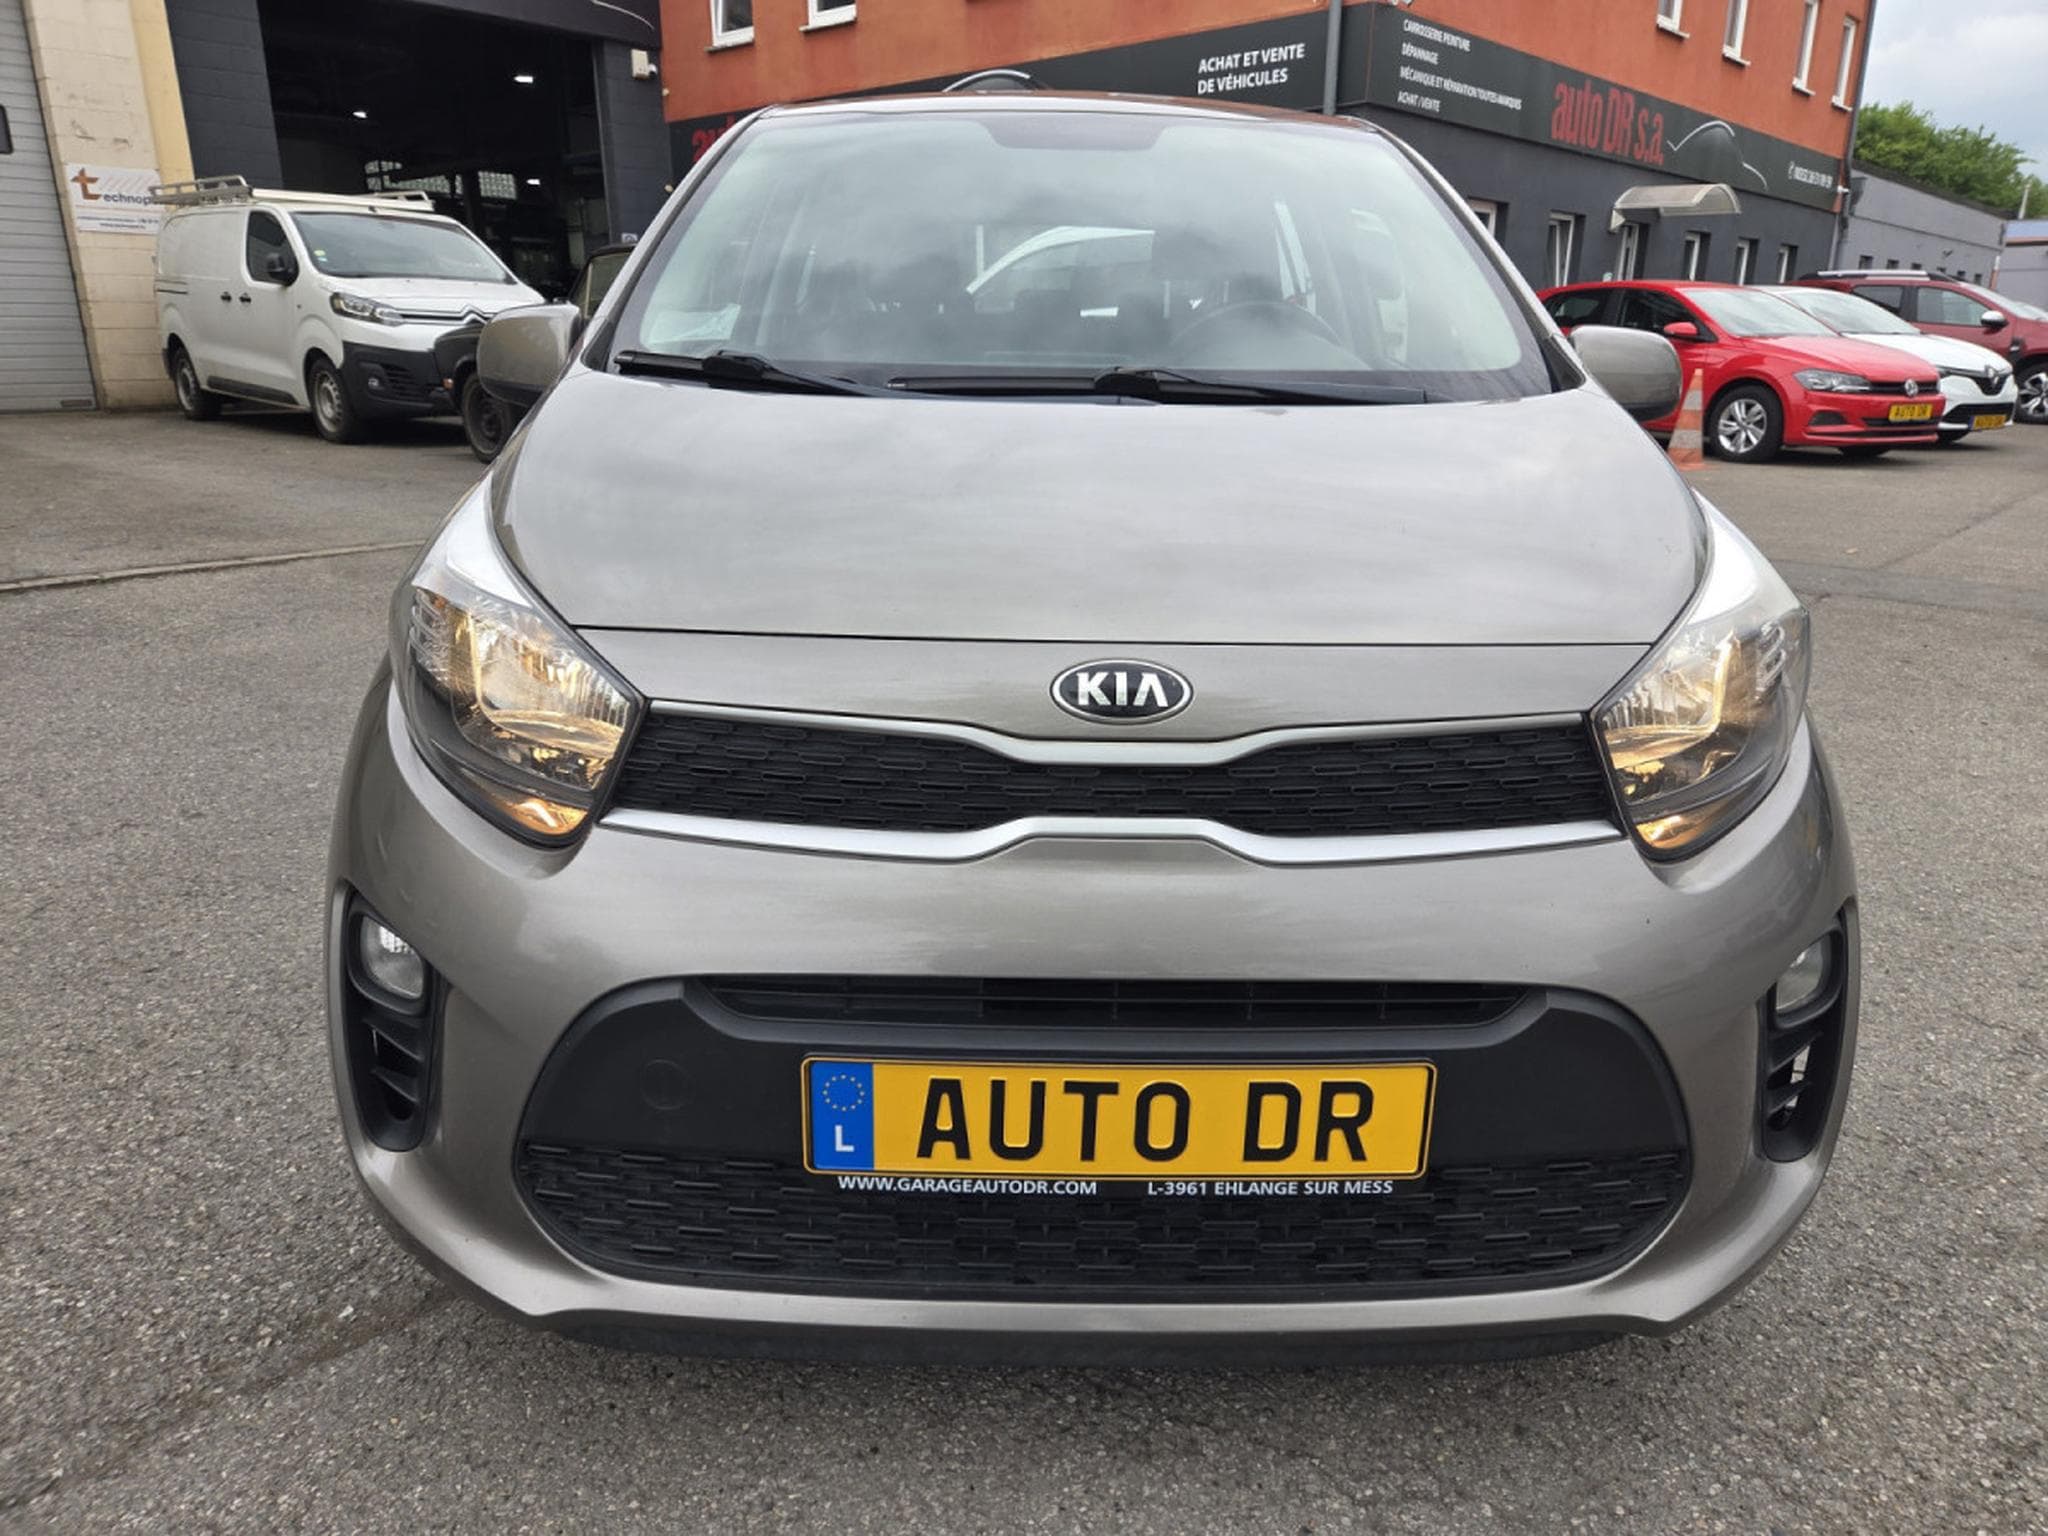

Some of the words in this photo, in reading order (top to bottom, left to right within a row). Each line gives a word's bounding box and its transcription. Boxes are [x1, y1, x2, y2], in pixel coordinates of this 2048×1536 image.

[1198, 53, 1241, 74] ACHAT
[1243, 50, 1259, 67] ET
[1261, 43, 1305, 64] VENTE
[1198, 79, 1215, 95] DE
[1217, 67, 1288, 92] VÉHICULES
[1552, 79, 1603, 149] auto
[1602, 87, 1635, 157] DR
[71, 167, 153, 206] technop
[1076, 671, 1169, 708] KIA
[835, 1125, 854, 1152] L
[916, 1077, 1192, 1163] AUTO
[1241, 1079, 1375, 1163] DR
[837, 1175, 1098, 1195] WWW.GARAGEAUTODR.COM
[1148, 1181, 1207, 1196] L-3961
[1214, 1181, 1299, 1196] EHLANGE
[1303, 1181, 1339, 1195] SUR
[1343, 1180, 1394, 1195] MESS
